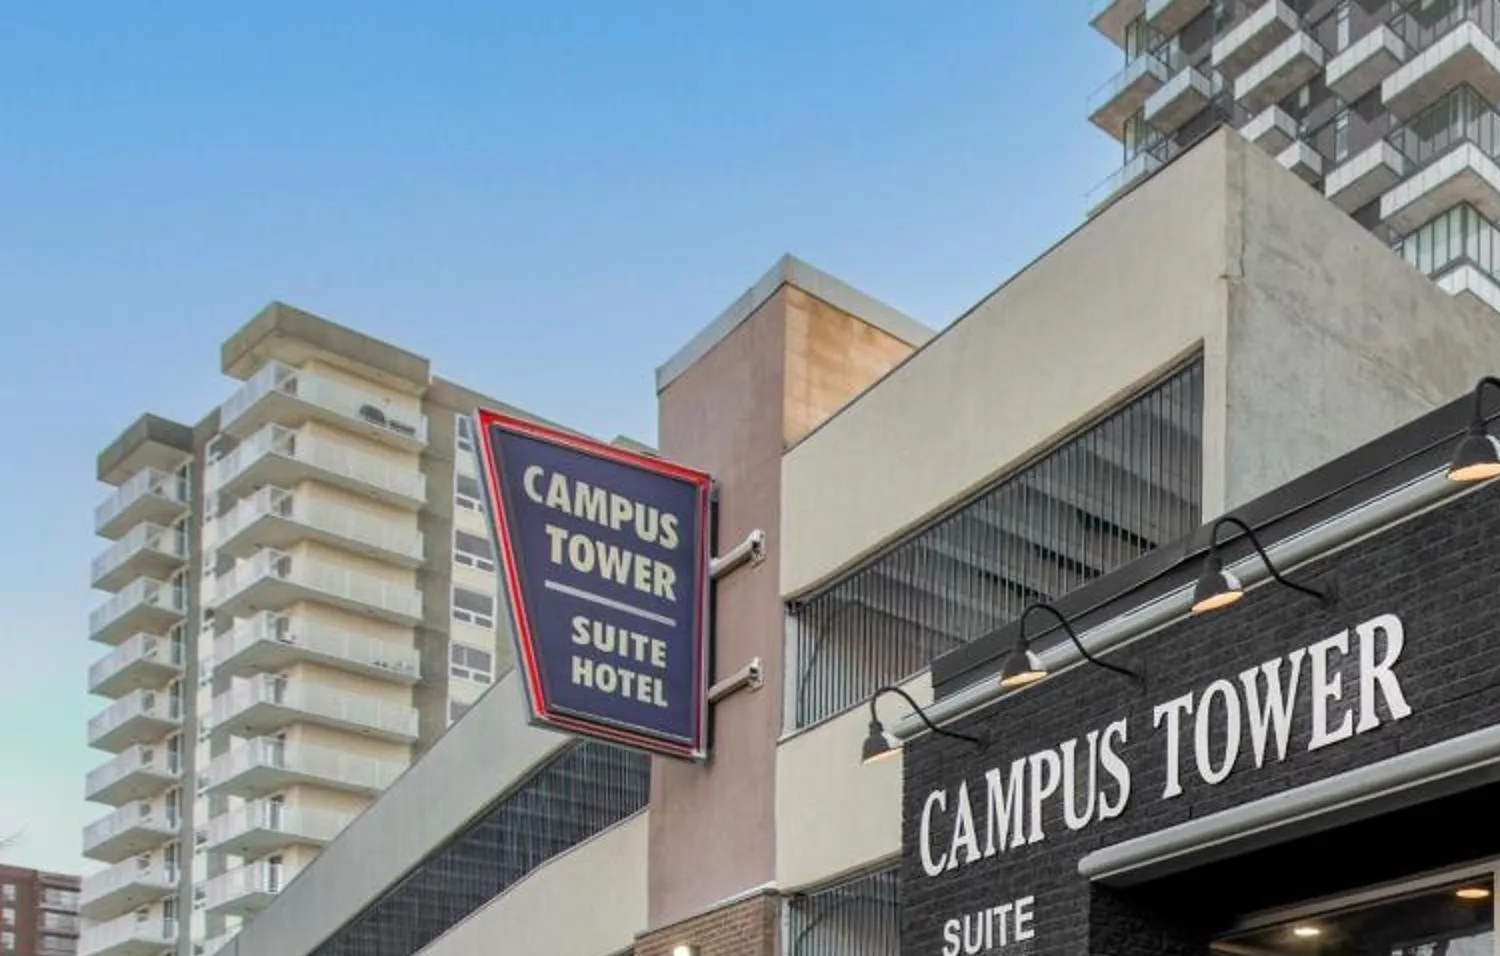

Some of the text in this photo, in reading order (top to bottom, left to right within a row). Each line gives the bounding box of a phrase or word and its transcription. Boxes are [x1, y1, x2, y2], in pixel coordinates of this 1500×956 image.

[523, 464, 680, 549] CAMPUS
[545, 523, 678, 602] TOWER
[571, 615, 668, 669] SUITE
[571, 656, 669, 708] HOTEL
[919, 613, 1413, 877] CAMPUS TOWER
